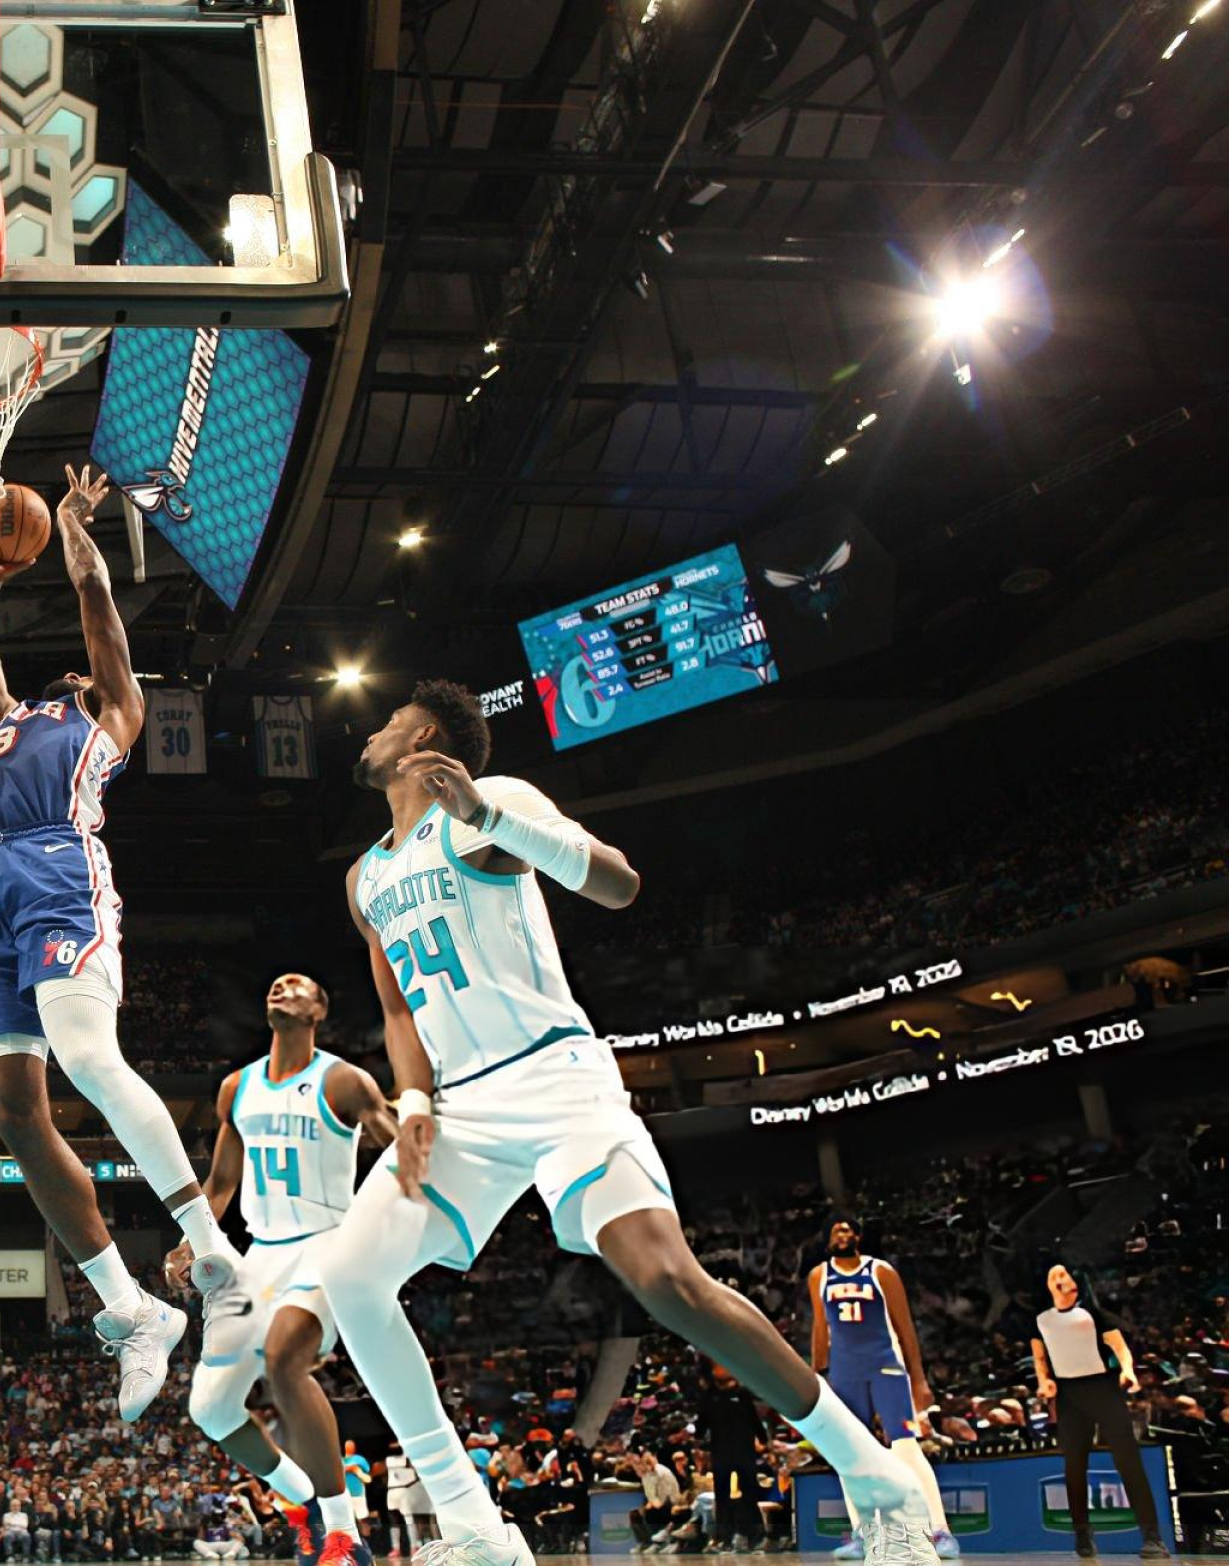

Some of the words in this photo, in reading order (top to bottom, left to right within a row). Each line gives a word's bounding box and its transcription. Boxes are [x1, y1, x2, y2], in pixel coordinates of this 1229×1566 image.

[168, 327, 219, 485] HIVEMENTAL
[674, 564, 719, 589] HORNETS
[594, 599, 626, 615] TEAM
[626, 583, 660, 602] STATS
[478, 680, 524, 706] OVANT
[482, 695, 524, 718] EALTH
[161, 726, 191, 758] 30
[385, 916, 471, 1012] 24
[248, 1147, 301, 1198] 14
